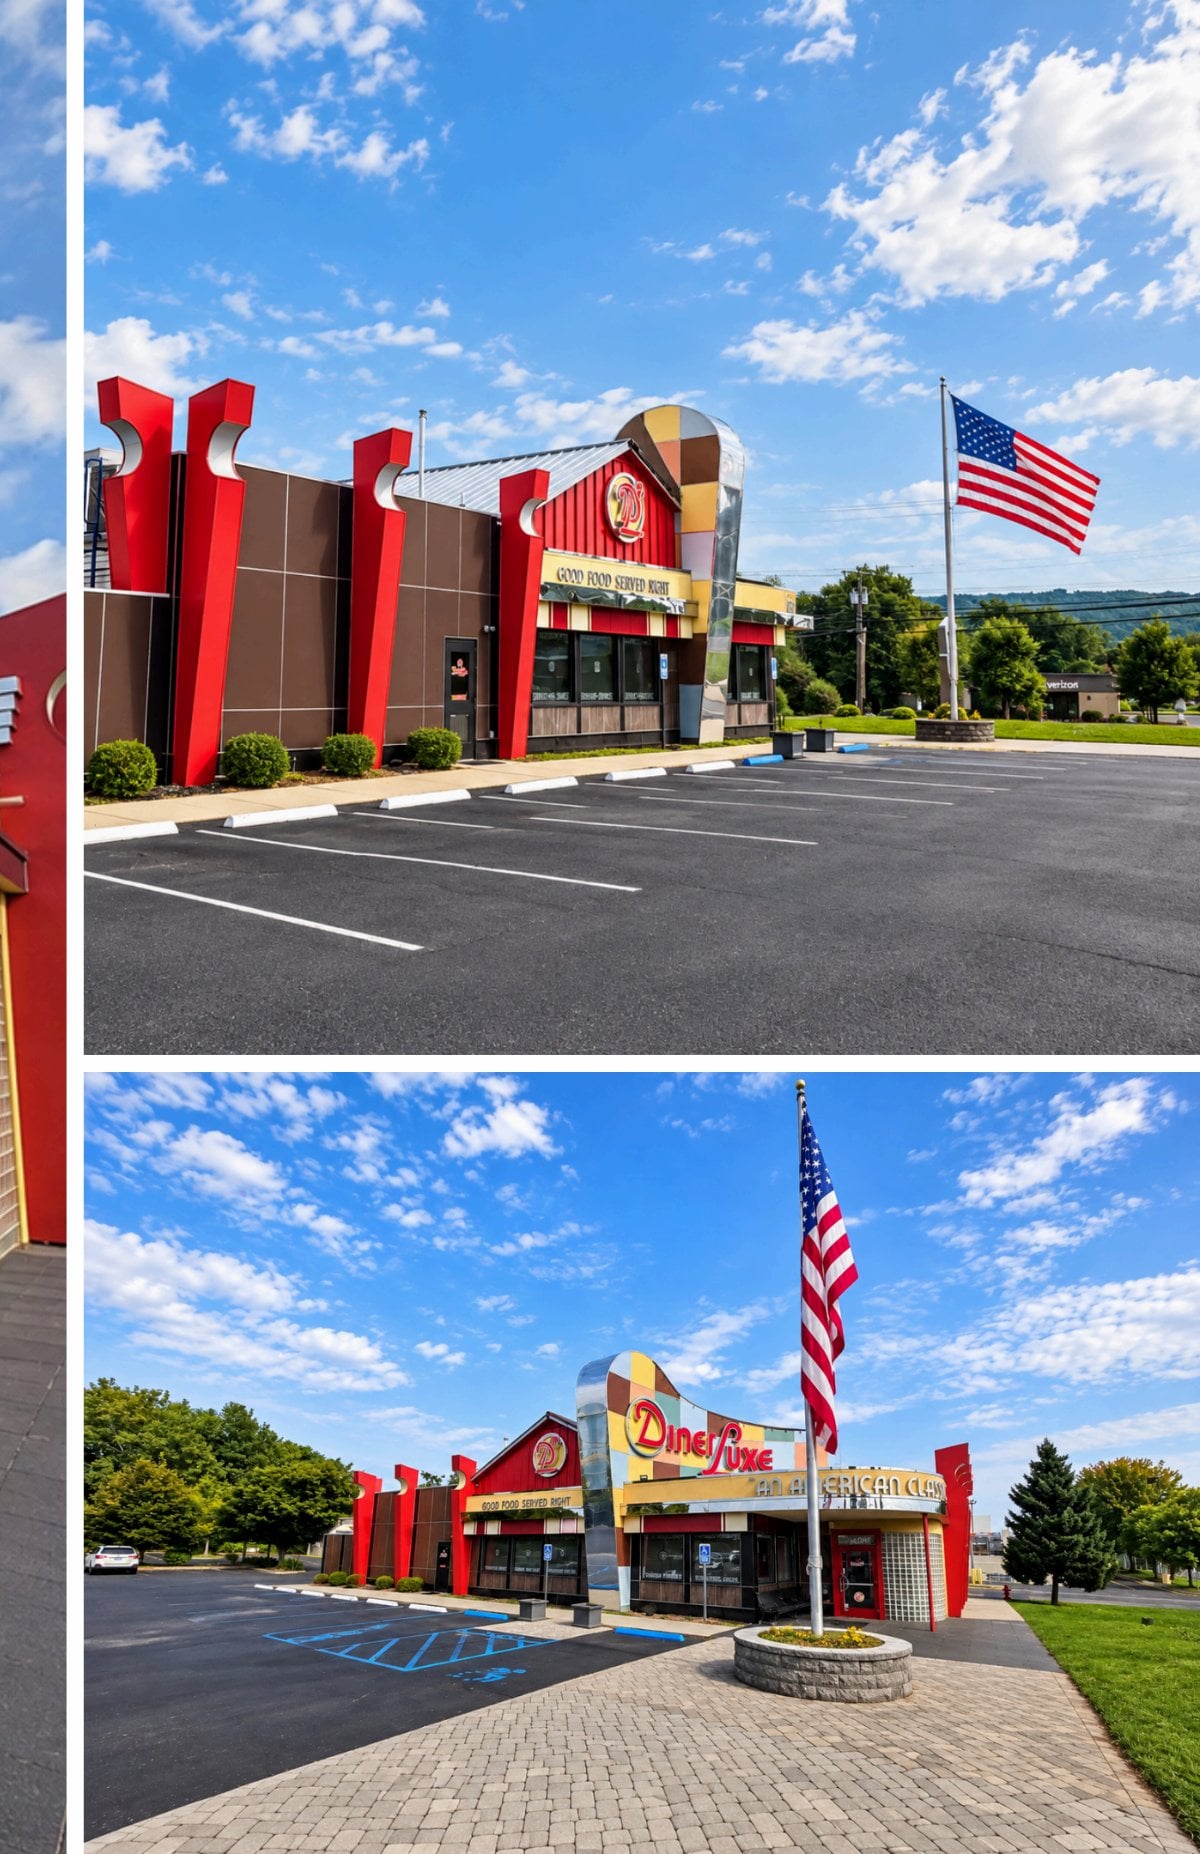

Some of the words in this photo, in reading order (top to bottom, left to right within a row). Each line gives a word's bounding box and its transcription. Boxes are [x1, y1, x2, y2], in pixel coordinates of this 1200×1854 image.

[557, 567, 584, 584] GOOD
[587, 570, 612, 588] FOOD
[615, 574, 646, 593] SERVED
[1046, 680, 1079, 689] verizon
[756, 1477, 782, 1497] AN
[482, 1501, 499, 1511] GOOD
[501, 1500, 519, 1509] FOOD
[522, 1498, 547, 1508] SERVED
[550, 1496, 571, 1506] RIGHT
